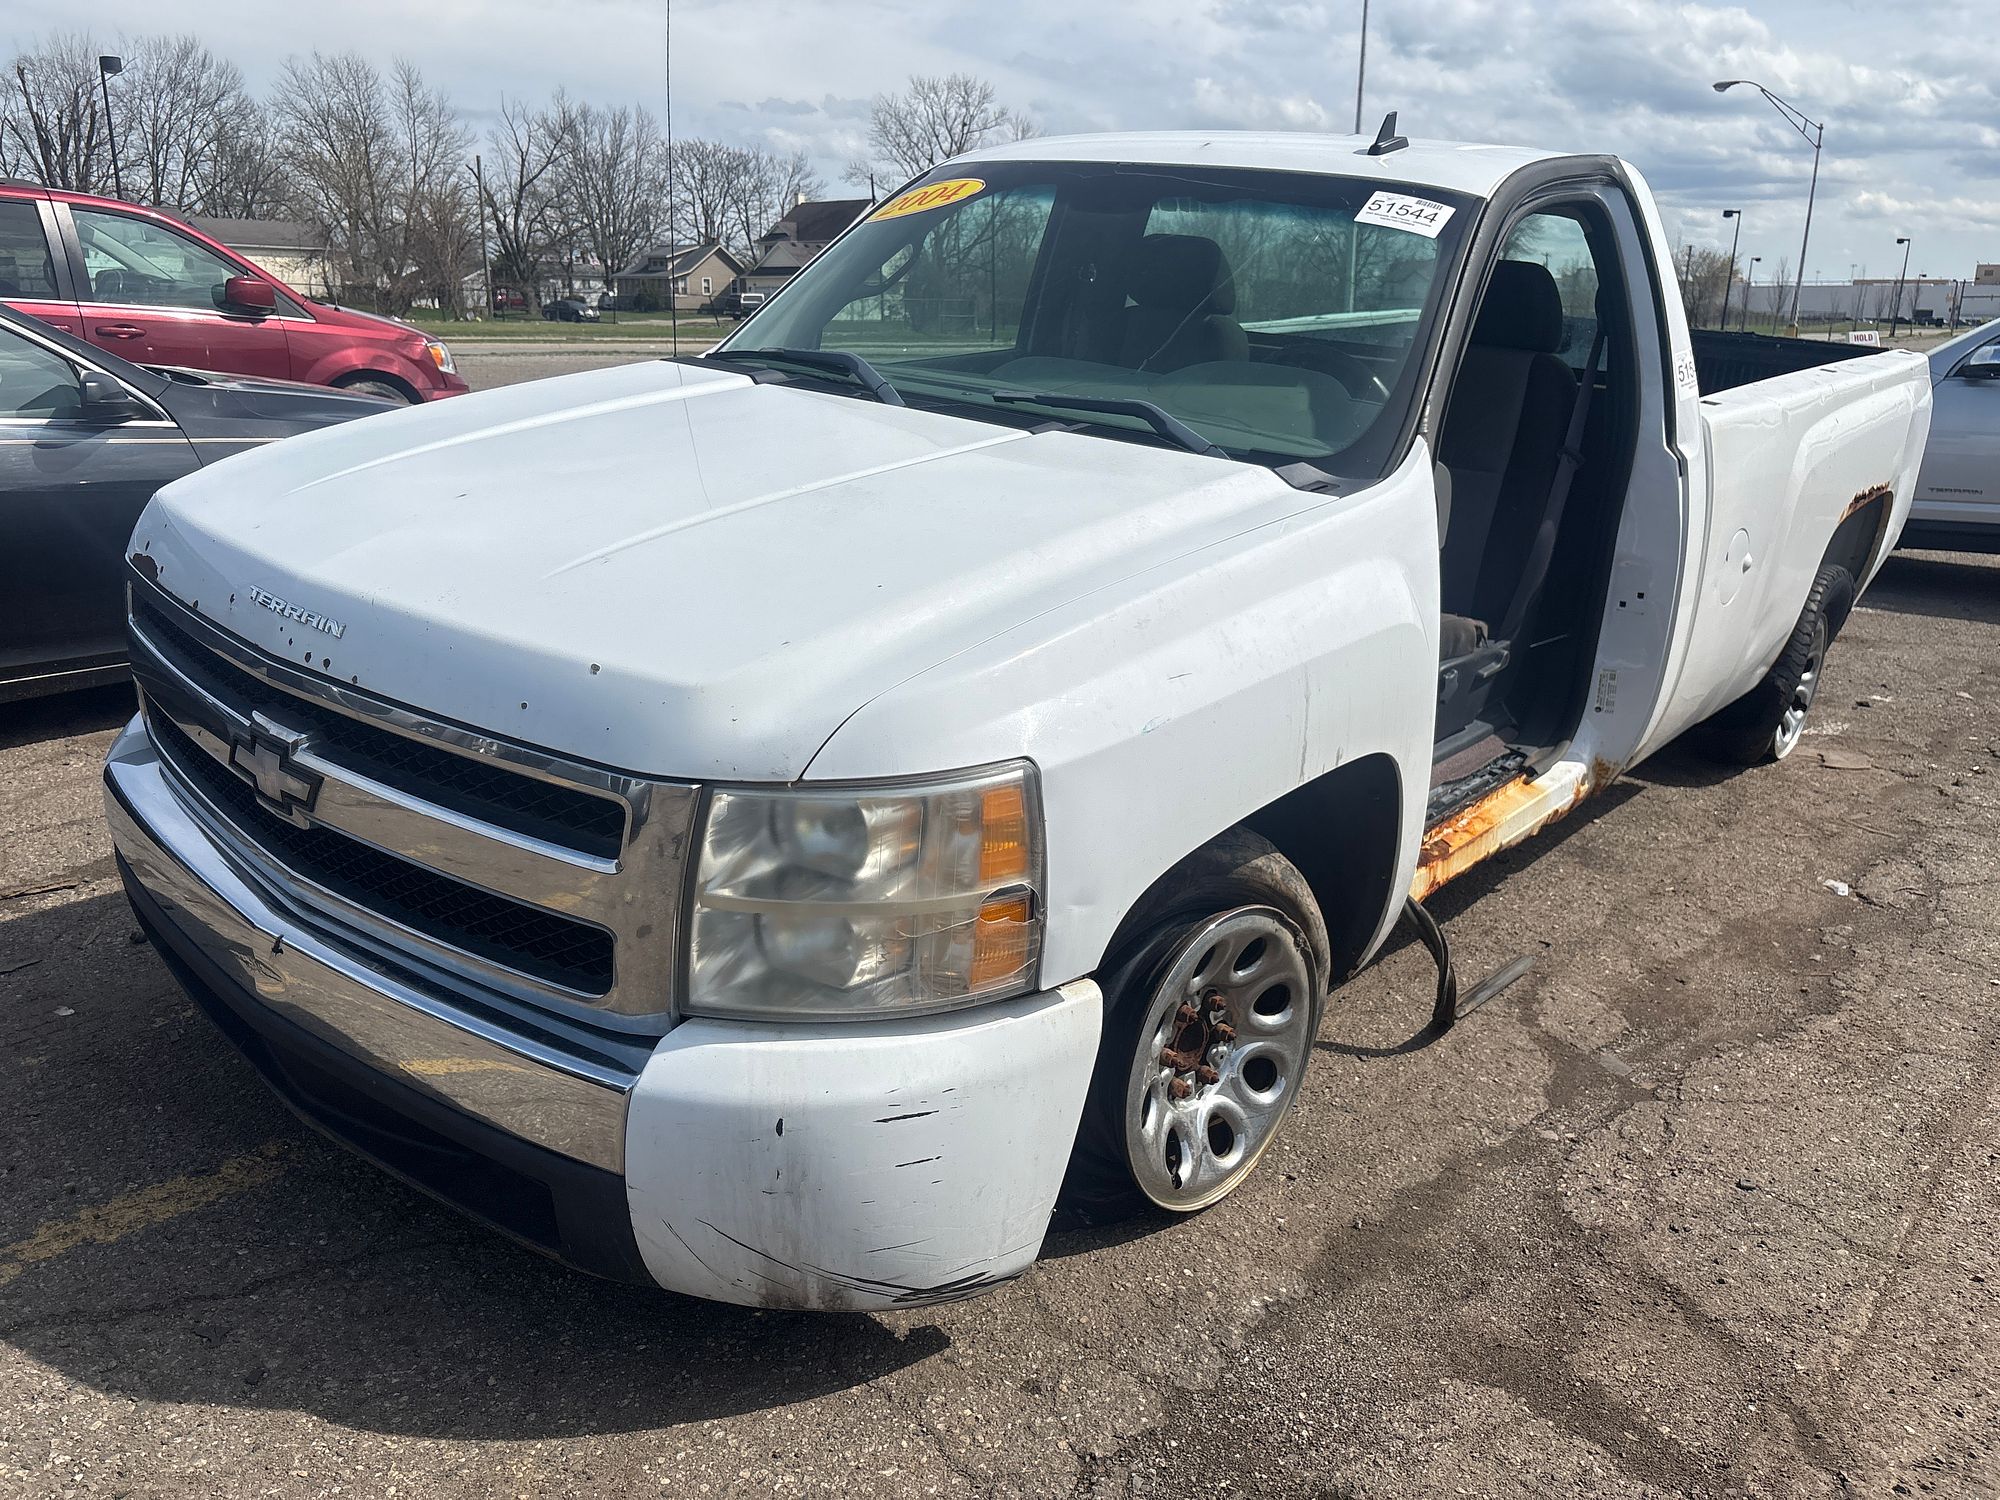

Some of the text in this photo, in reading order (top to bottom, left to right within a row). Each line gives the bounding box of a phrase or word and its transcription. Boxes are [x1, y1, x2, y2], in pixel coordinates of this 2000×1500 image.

[876, 182, 969, 218] 2004
[1367, 199, 1439, 223] 51544
[1853, 333, 1874, 342] HOLD
[1678, 360, 1696, 383] 515
[1927, 486, 1984, 496] TERRAIN
[249, 584, 347, 640] TERRAIN
